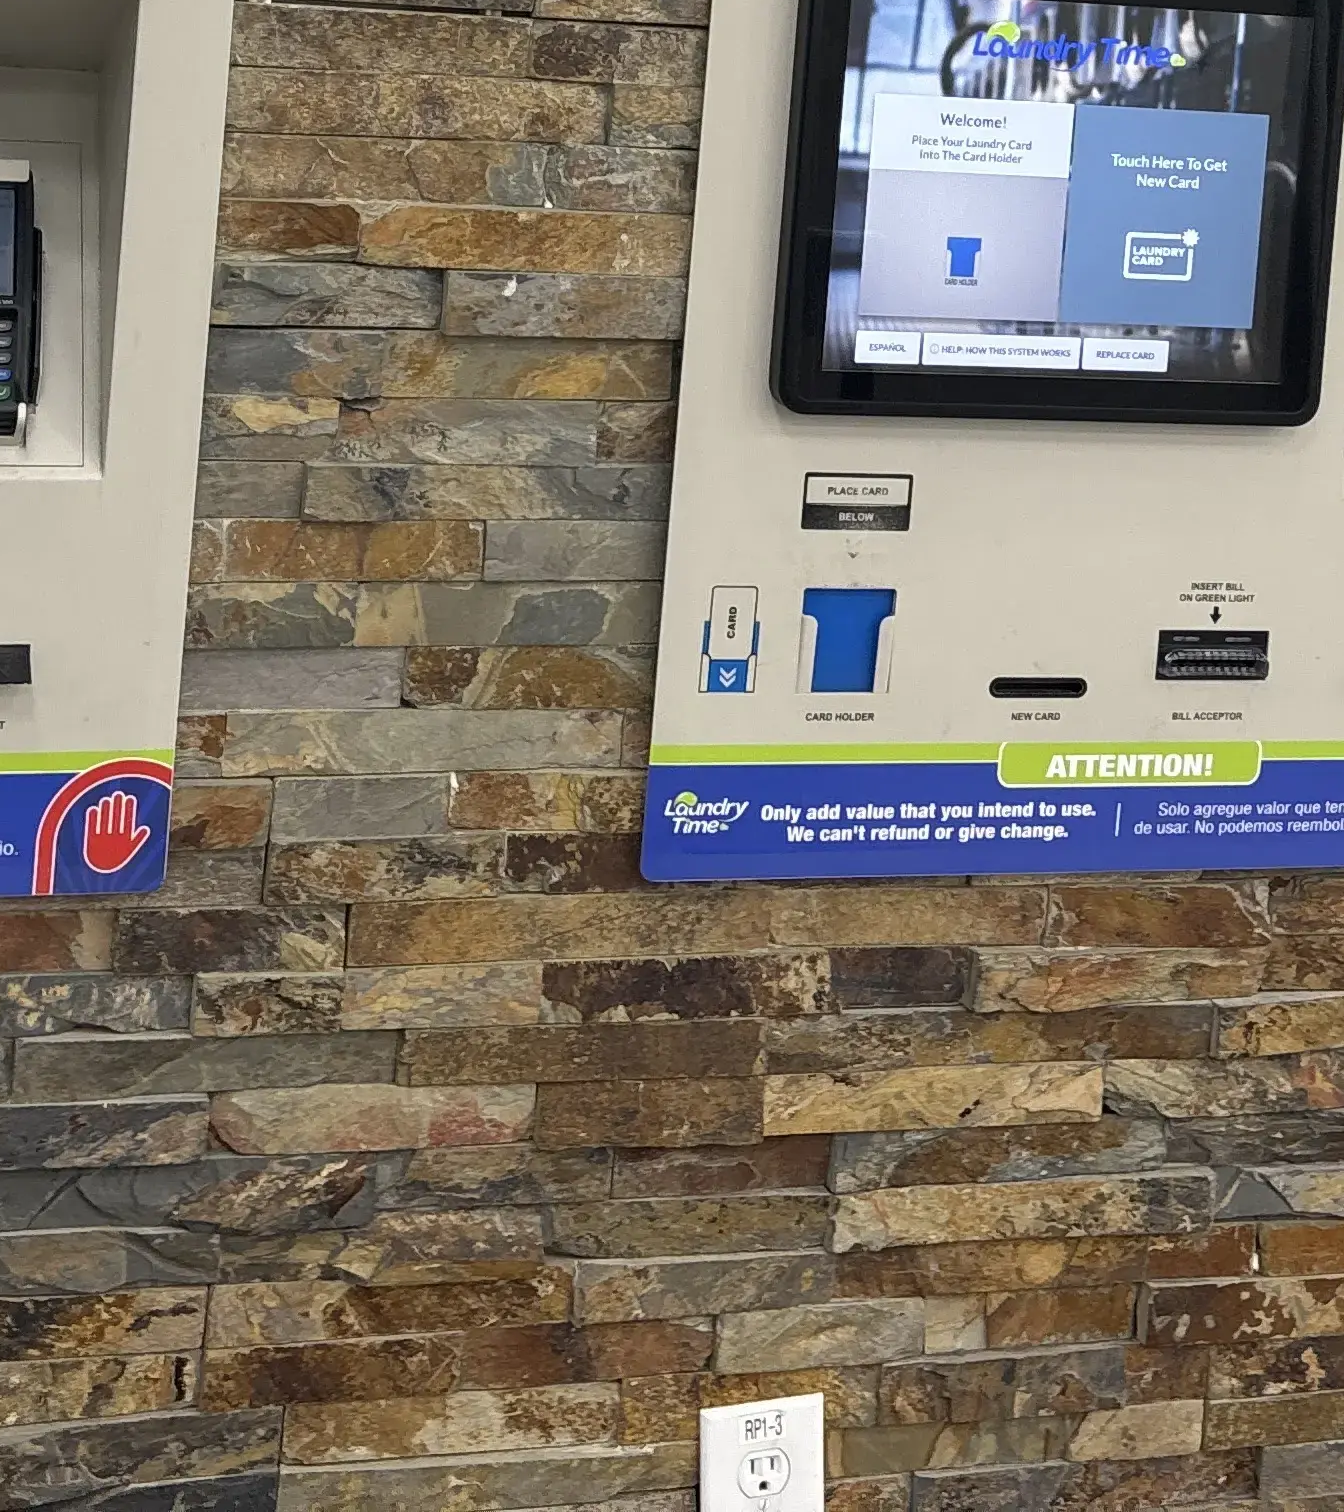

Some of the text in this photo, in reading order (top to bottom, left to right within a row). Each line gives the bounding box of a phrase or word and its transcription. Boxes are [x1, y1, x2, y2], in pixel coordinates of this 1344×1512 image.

[972, 31, 1170, 69] Laundry Time
[940, 113, 1008, 129] Welcome!
[1046, 753, 1213, 779] ATTENTION!
[1158, 802, 1190, 816] Solo
[1194, 802, 1252, 819] agregue
[1256, 801, 1291, 815] valor
[1295, 802, 1321, 816] que
[745, 1414, 783, 1441] RP1-3
